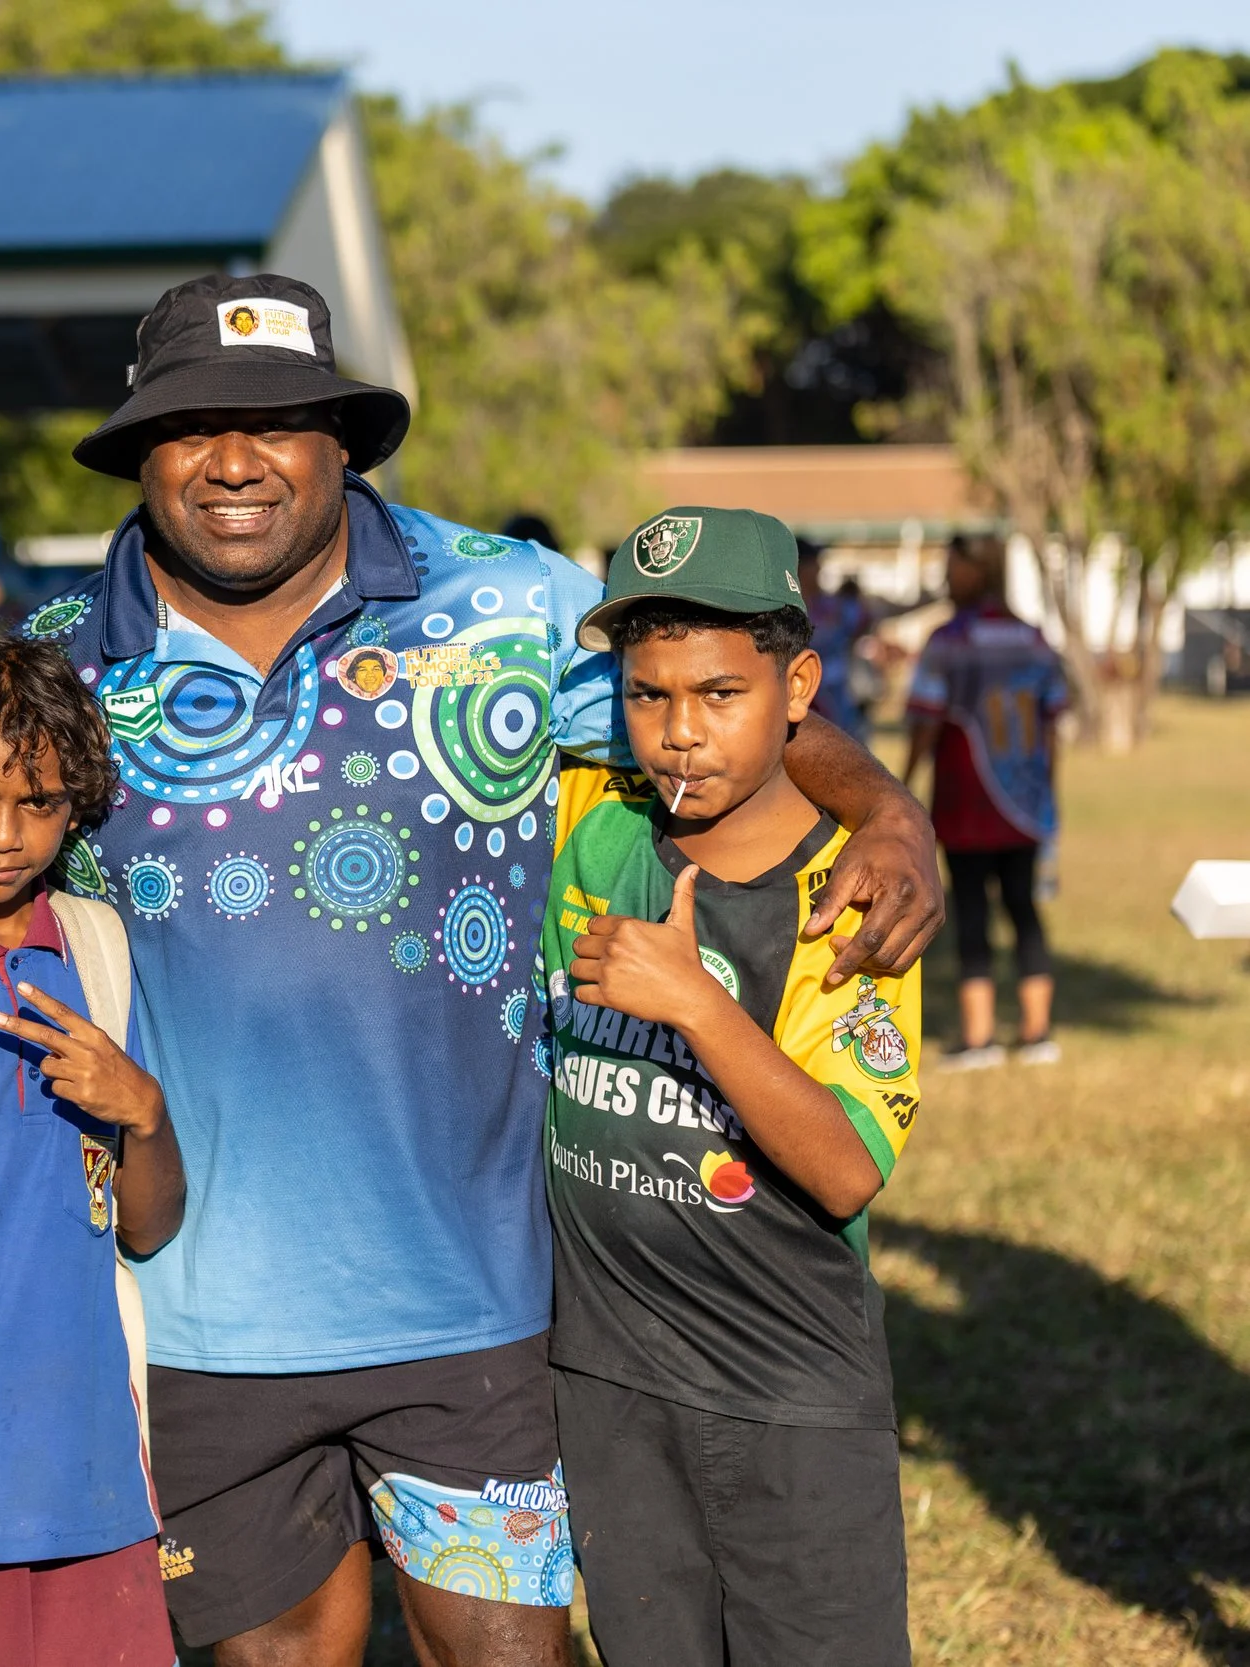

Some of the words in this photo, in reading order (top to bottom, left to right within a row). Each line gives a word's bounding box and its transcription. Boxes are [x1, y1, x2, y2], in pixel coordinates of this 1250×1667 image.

[641, 521, 692, 540] RAIDERS
[405, 647, 470, 662] FUTURE
[406, 657, 501, 675] IMMORTALS
[407, 673, 453, 689] TOUR
[111, 694, 152, 706] NRL
[700, 951, 727, 974] REEBA
[551, 1126, 603, 1187] lourish
[609, 1158, 702, 1205] Plants
